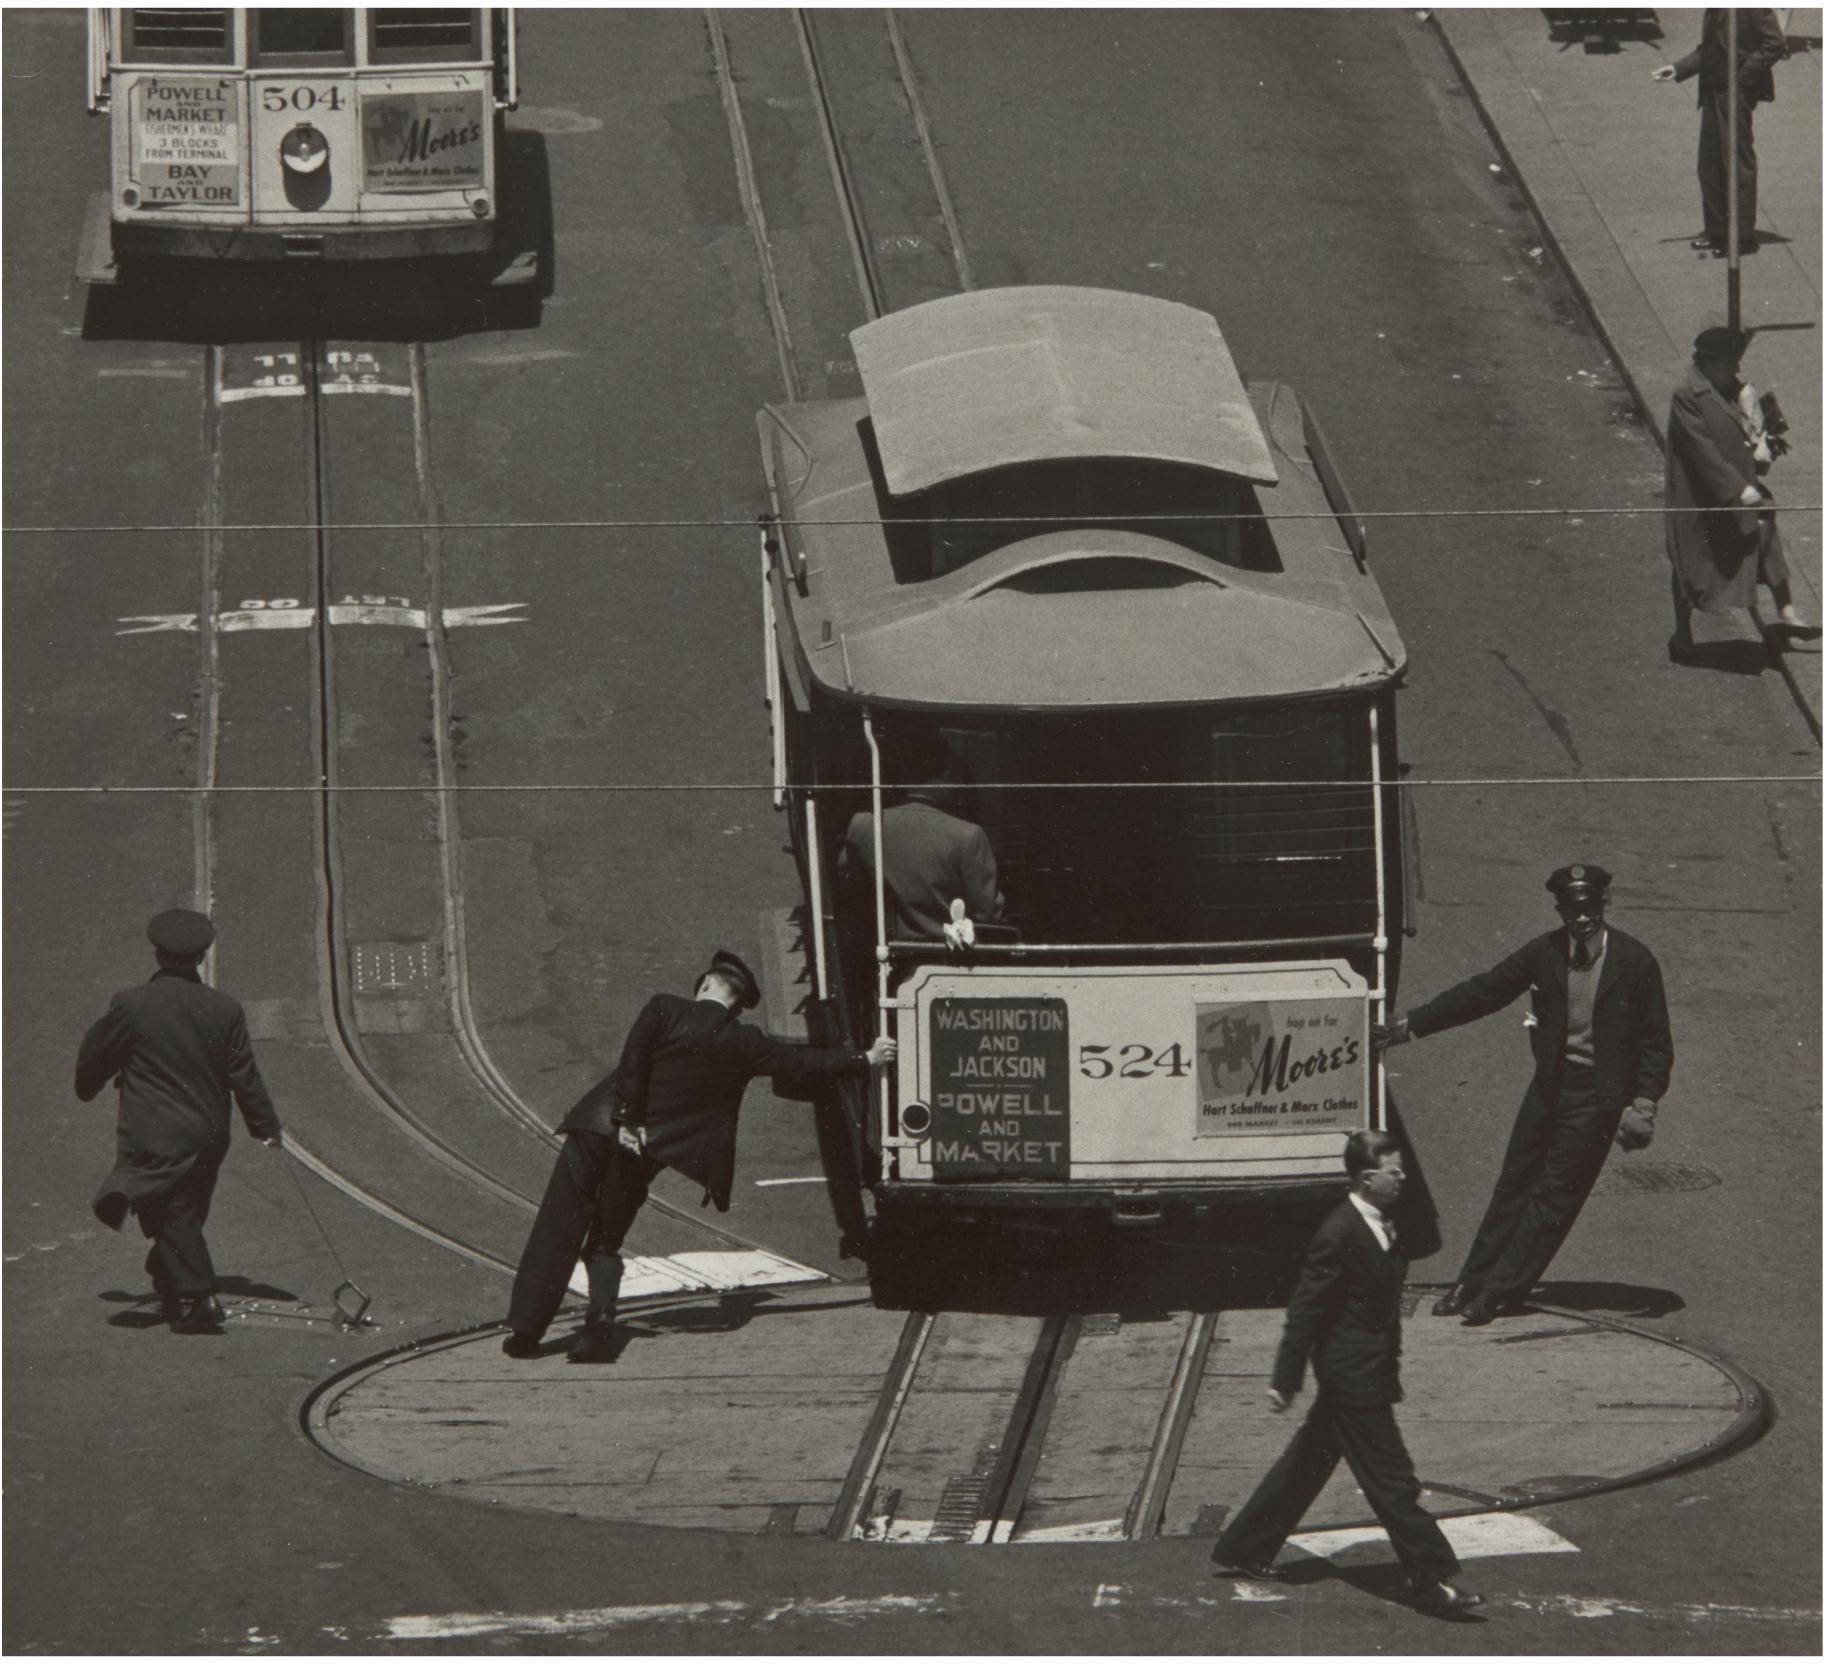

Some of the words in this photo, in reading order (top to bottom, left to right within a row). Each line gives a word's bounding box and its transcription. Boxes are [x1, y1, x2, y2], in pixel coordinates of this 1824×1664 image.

[147, 86, 227, 102] POWELL
[263, 86, 346, 112] 504
[146, 108, 226, 122] MARKET
[160, 137, 167, 148] 3
[171, 137, 218, 148] BLOCKS
[398, 118, 480, 164] Moore's
[145, 148, 173, 159] FROM
[176, 148, 230, 160] TERMINAL
[168, 164, 213, 180] BAY
[148, 185, 233, 201] TAYLOR
[935, 1008, 1065, 1031] WASHINGTON
[1287, 1016, 1305, 1030] hop
[1308, 1018, 1322, 1028] on
[1324, 1014, 1338, 1026] for
[979, 1034, 1020, 1052] AND
[949, 1055, 1047, 1079] JACKSON
[1079, 1041, 1192, 1080] 524
[1246, 1034, 1360, 1098] Moore's
[936, 1093, 1063, 1116] POWELL
[1202, 1103, 1227, 1116] Hart
[1229, 1101, 1279, 1115] Schaffner
[1280, 1102, 1289, 1114] &
[1291, 1100, 1319, 1113] Marx
[1322, 1097, 1359, 1112] Clothes
[979, 1120, 1020, 1136] AND
[936, 1140, 1063, 1163] MARKET
